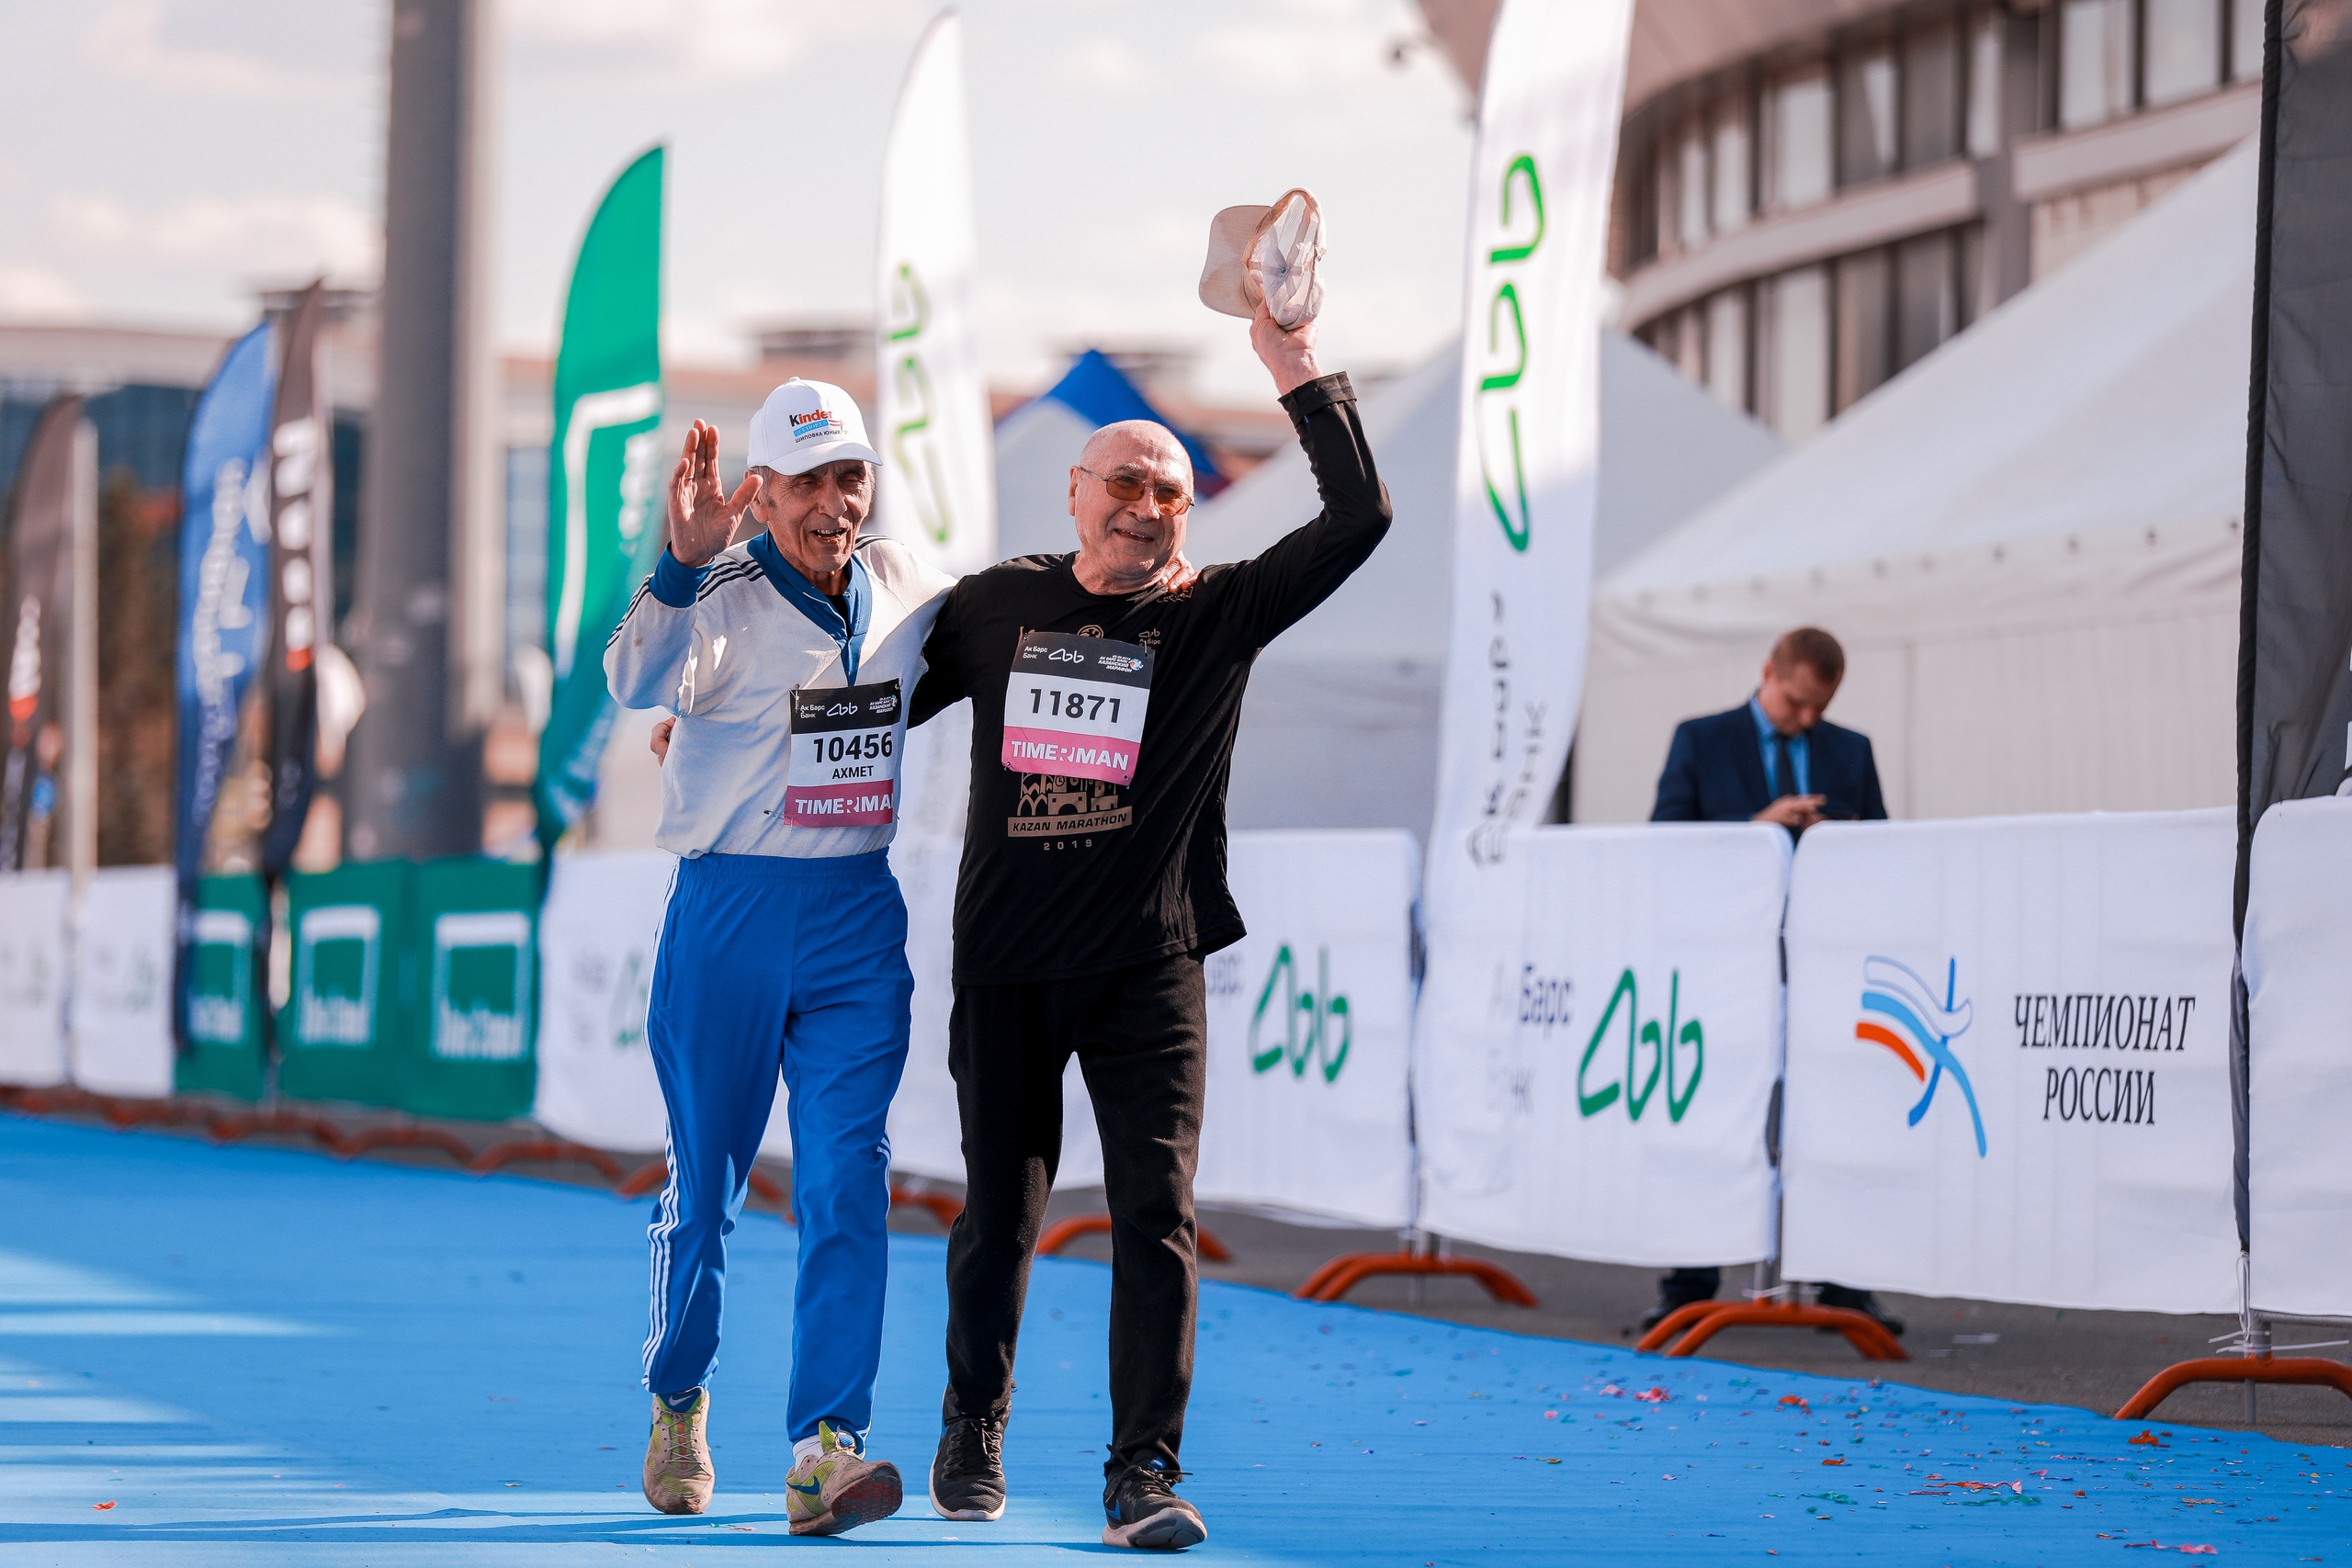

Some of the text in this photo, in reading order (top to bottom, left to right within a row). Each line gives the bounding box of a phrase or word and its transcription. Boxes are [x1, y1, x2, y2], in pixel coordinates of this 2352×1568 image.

[789, 410, 832, 427] Kinder
[795, 432, 823, 443] ШИПОВКА
[1033, 646, 1047, 654] Барс
[809, 704, 825, 712] Барс
[1030, 688, 1121, 724] 11871
[813, 731, 892, 763] 10456
[832, 765, 874, 779] АХМЕТ
[795, 793, 893, 815] TIMERMA
[1012, 812, 1127, 832] KAZAN MARATHON
[2015, 995, 2196, 1051] ЧЕМПИОНАТ
[2042, 1066, 2155, 1124] РОССИИ
